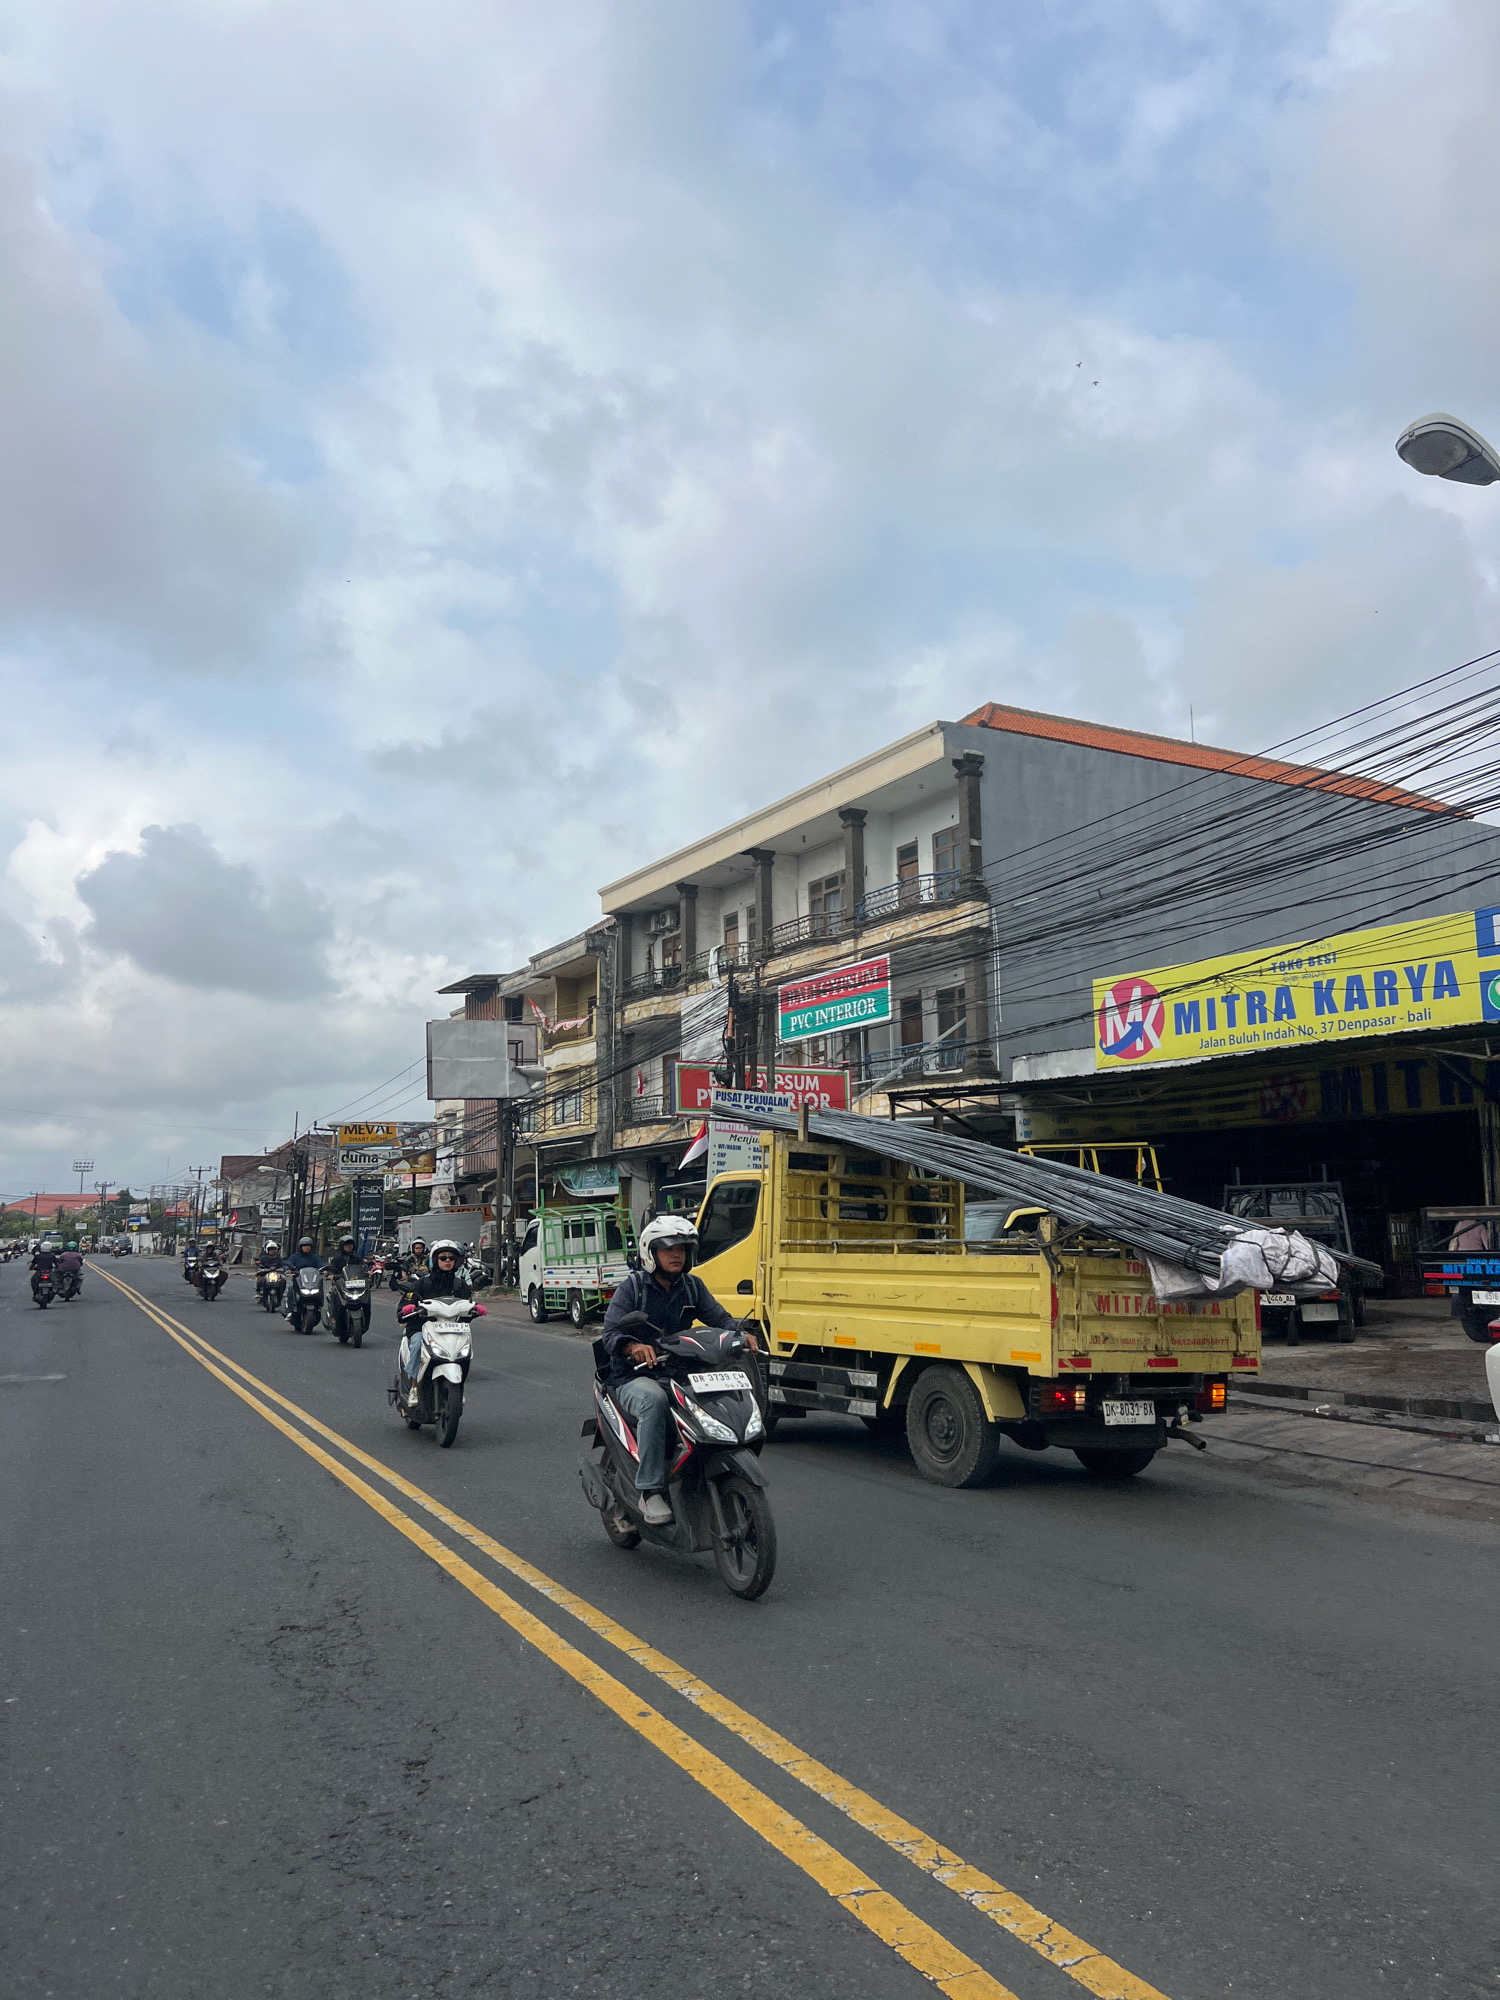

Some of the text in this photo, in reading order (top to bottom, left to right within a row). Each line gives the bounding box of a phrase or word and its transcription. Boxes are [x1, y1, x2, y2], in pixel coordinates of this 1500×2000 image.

[1271, 958, 1303, 973] TOKO
[1174, 960, 1461, 1036] MITRA KARYA
[790, 998, 877, 1032] PVC INTERIOR
[1199, 1036, 1226, 1050] Jalan
[1229, 1030, 1260, 1046] Buluh
[1263, 1027, 1295, 1042] Indah
[1298, 1024, 1318, 1037] No.
[1320, 1021, 1334, 1034] 37
[1338, 1015, 1397, 1033] Denpasar
[1407, 1008, 1432, 1023] bali
[715, 1090, 743, 1103] PUSAT
[744, 1094, 789, 1107] PENJUALAN
[344, 1124, 393, 1134] MEVAL
[729, 1134, 760, 1144] Menju
[341, 1150, 378, 1163] duma
[1443, 1264, 1483, 1274] MITRA
[707, 1373, 730, 1381] 3739
[1105, 1402, 1154, 1417] DK 8031 BX
